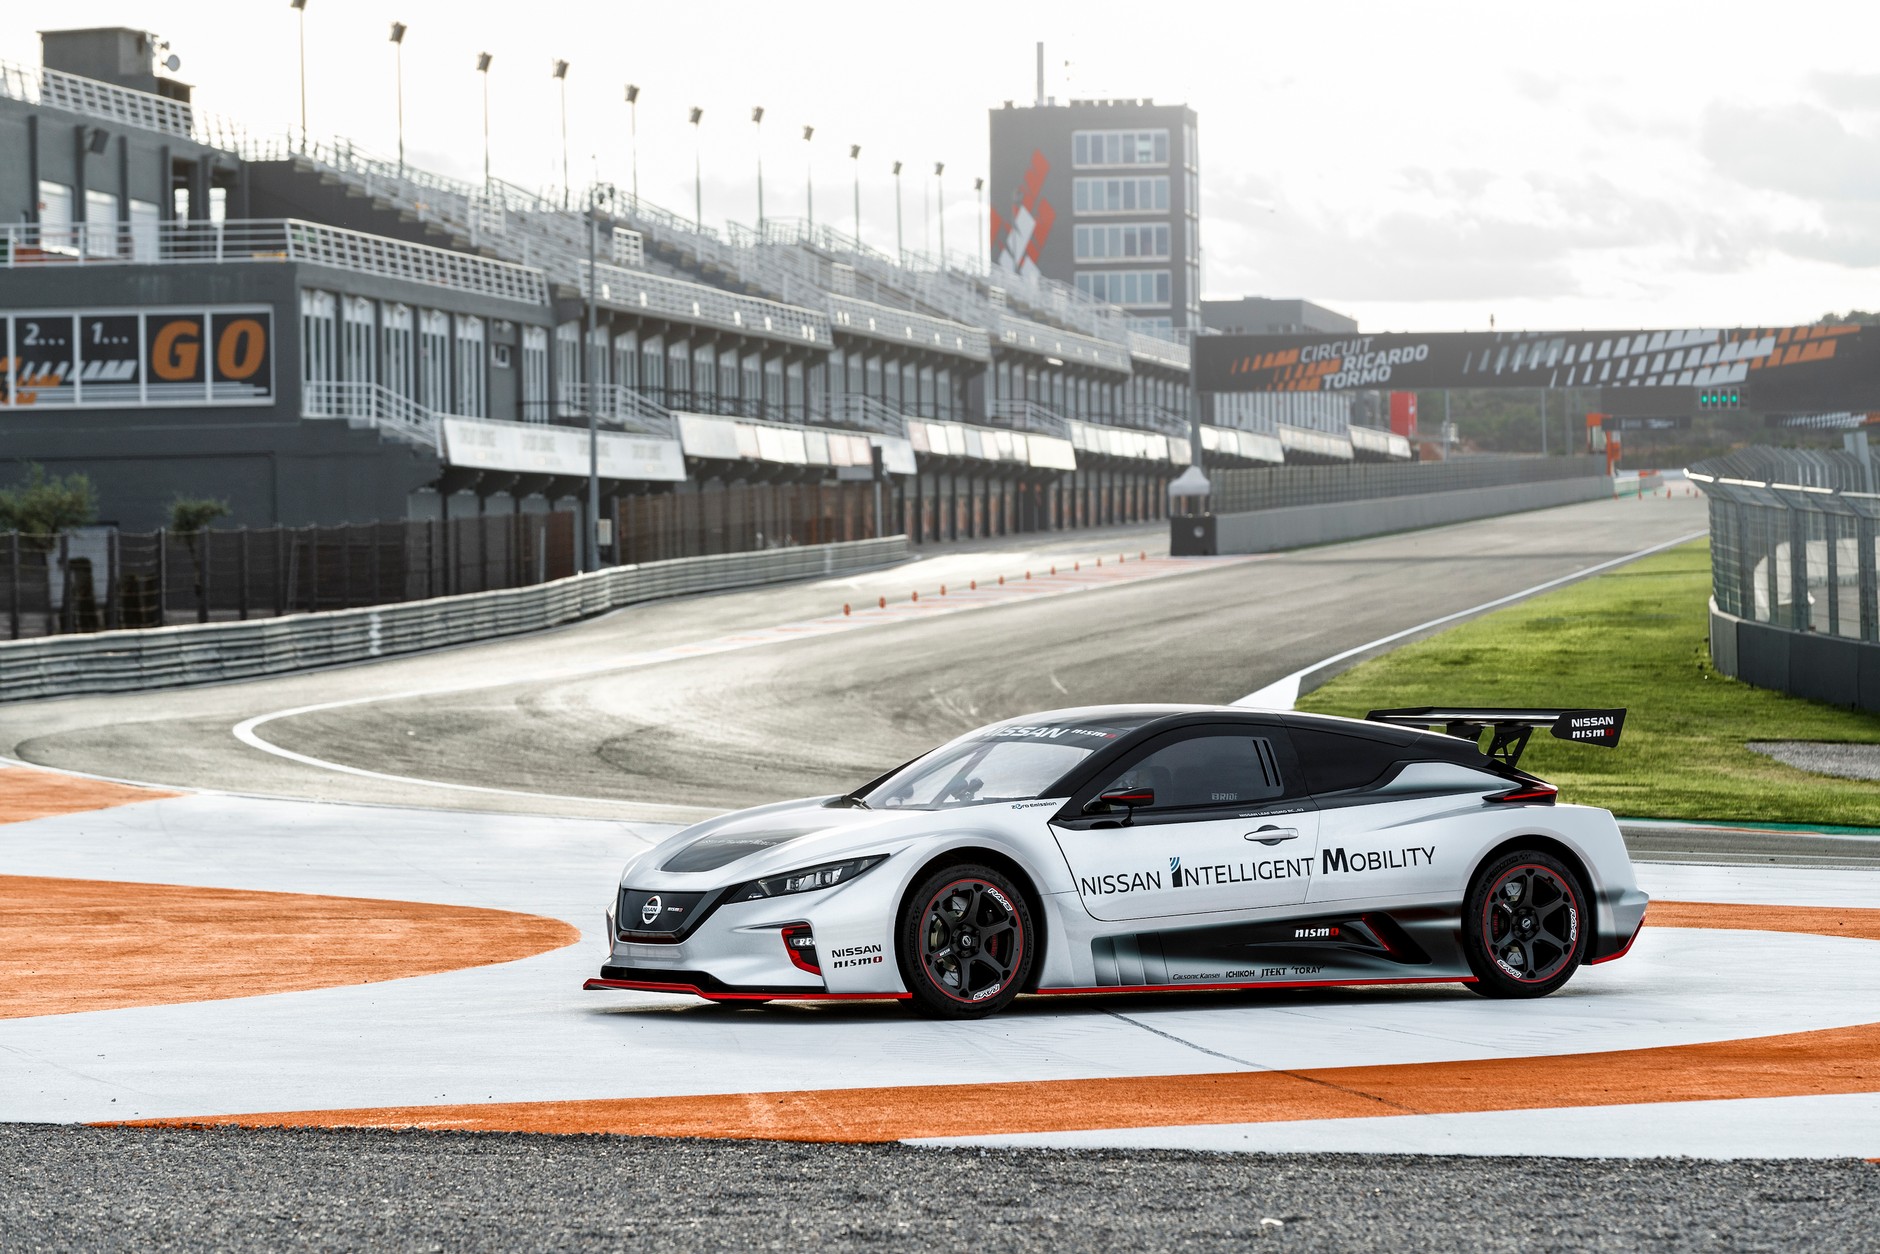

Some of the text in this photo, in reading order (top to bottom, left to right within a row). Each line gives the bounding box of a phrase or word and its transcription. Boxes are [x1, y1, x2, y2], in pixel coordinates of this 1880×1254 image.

[152, 319, 266, 381] GO
[1300, 336, 1374, 364] CIRCUIT
[1342, 345, 1429, 371] RICARDO
[1323, 366, 1392, 390] TORMO
[1571, 716, 1614, 728] NISSAN
[1572, 728, 1615, 739] nismo
[1081, 845, 1436, 897] NISSAN INTELLIGENT MOBILITY
[1294, 927, 1340, 938] nismo
[831, 944, 882, 958] NISSAN
[833, 955, 883, 968] nismo
[1225, 969, 1255, 979] ICHIKOH
[1260, 967, 1287, 978] JTEKT
